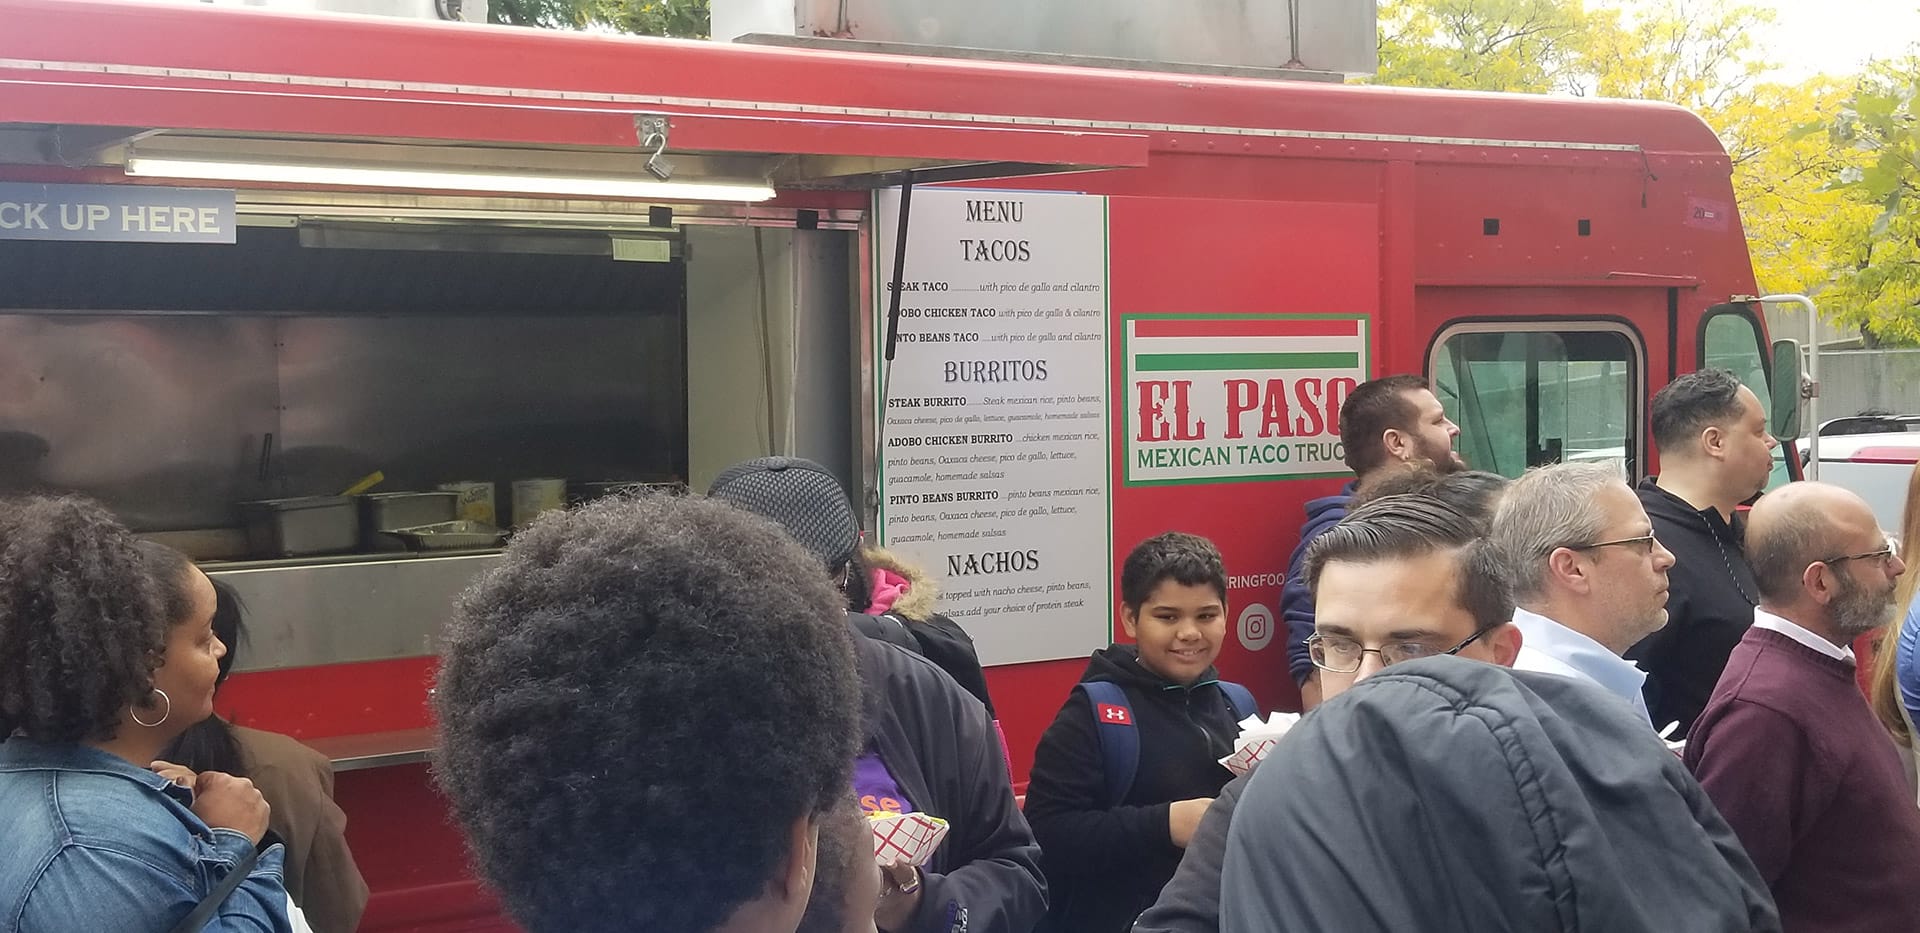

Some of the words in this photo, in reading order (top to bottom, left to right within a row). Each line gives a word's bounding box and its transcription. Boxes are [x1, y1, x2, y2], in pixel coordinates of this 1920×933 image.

[60, 203, 111, 231] UP
[121, 205, 220, 234] HERE
[966, 200, 1024, 223] MENU
[960, 239, 1030, 261] TACOS
[887, 282, 920, 292] SEAK
[922, 282, 949, 292] TACO
[979, 283, 998, 292] with
[1000, 284, 1017, 294] pico
[1019, 283, 1029, 292] de
[1031, 283, 1050, 294] gallo
[1052, 283, 1068, 292] and
[1070, 283, 1100, 292] cilantro
[888, 308, 922, 318] OBO
[924, 308, 968, 318] CHICKEN
[970, 308, 996, 318] TACO
[999, 308, 1016, 318] with
[1016, 310, 1032, 319] pico
[1034, 308, 1044, 317] de
[1045, 308, 1064, 319] gallo
[1065, 308, 1072, 318] &
[1073, 308, 1100, 317] cilantro
[895, 333, 916, 343] NTO
[919, 333, 950, 343] BEANS
[954, 333, 979, 342] TACO
[991, 334, 1008, 343] with
[1009, 335, 1025, 343] pico
[1027, 333, 1037, 342] de
[1038, 333, 1056, 343] gallo
[1058, 332, 1073, 341] and
[1074, 332, 1102, 341] cilantro
[944, 359, 1048, 383] BURRITOS
[888, 399, 921, 408] STEAK
[924, 397, 966, 407] BURRITO
[983, 397, 1005, 406] Steak
[1008, 397, 1038, 405] mexican
[1056, 395, 1074, 406] pinto
[886, 416, 912, 425] Oaxaca
[939, 416, 954, 425] pico
[955, 414, 963, 423] de
[1136, 380, 1205, 442] EL
[888, 437, 922, 448] ADOBO
[924, 436, 968, 446] CHICKEN
[971, 434, 1013, 444] BURRITO
[1022, 433, 1050, 442] chicken
[1052, 433, 1082, 441] mexican
[888, 458, 908, 468] pinto
[910, 457, 936, 466] beans,
[938, 456, 968, 465] Oaxaca
[1000, 455, 1015, 464] pico
[1017, 452, 1027, 462] de
[1137, 446, 1231, 468] MEXICAN
[1237, 444, 1290, 464] TACO
[1295, 442, 1345, 462] TRUC
[888, 475, 934, 486] guacamole,
[936, 472, 978, 482] homemade
[980, 471, 1005, 480] salsas
[890, 495, 919, 505] PINTO
[922, 493, 954, 504] BEANS
[956, 491, 999, 502] BURRITO
[1008, 490, 1027, 501] pinto
[1029, 489, 1051, 498] beans
[1053, 488, 1083, 497] mexican
[888, 514, 909, 526] pinto
[911, 513, 937, 523] beans,
[939, 511, 968, 521] Oaxaca
[1000, 510, 1016, 520] pico
[1017, 507, 1027, 517] de
[890, 532, 935, 546] guacamole,
[937, 530, 979, 541] homemade
[981, 529, 1006, 538] salsas
[947, 550, 1039, 577] NACHOS
[1226, 573, 1285, 589] RINGFOO
[945, 590, 972, 602] topped
[974, 588, 990, 598] with
[992, 586, 1016, 596] nacho
[1017, 584, 1045, 595] cheese,
[1046, 583, 1065, 594] pinto
[966, 606, 982, 617] add
[983, 605, 1000, 617] your
[1002, 602, 1026, 613] choice
[1027, 602, 1036, 613] of
[1036, 600, 1062, 612] protein
[1063, 599, 1084, 608] steak
